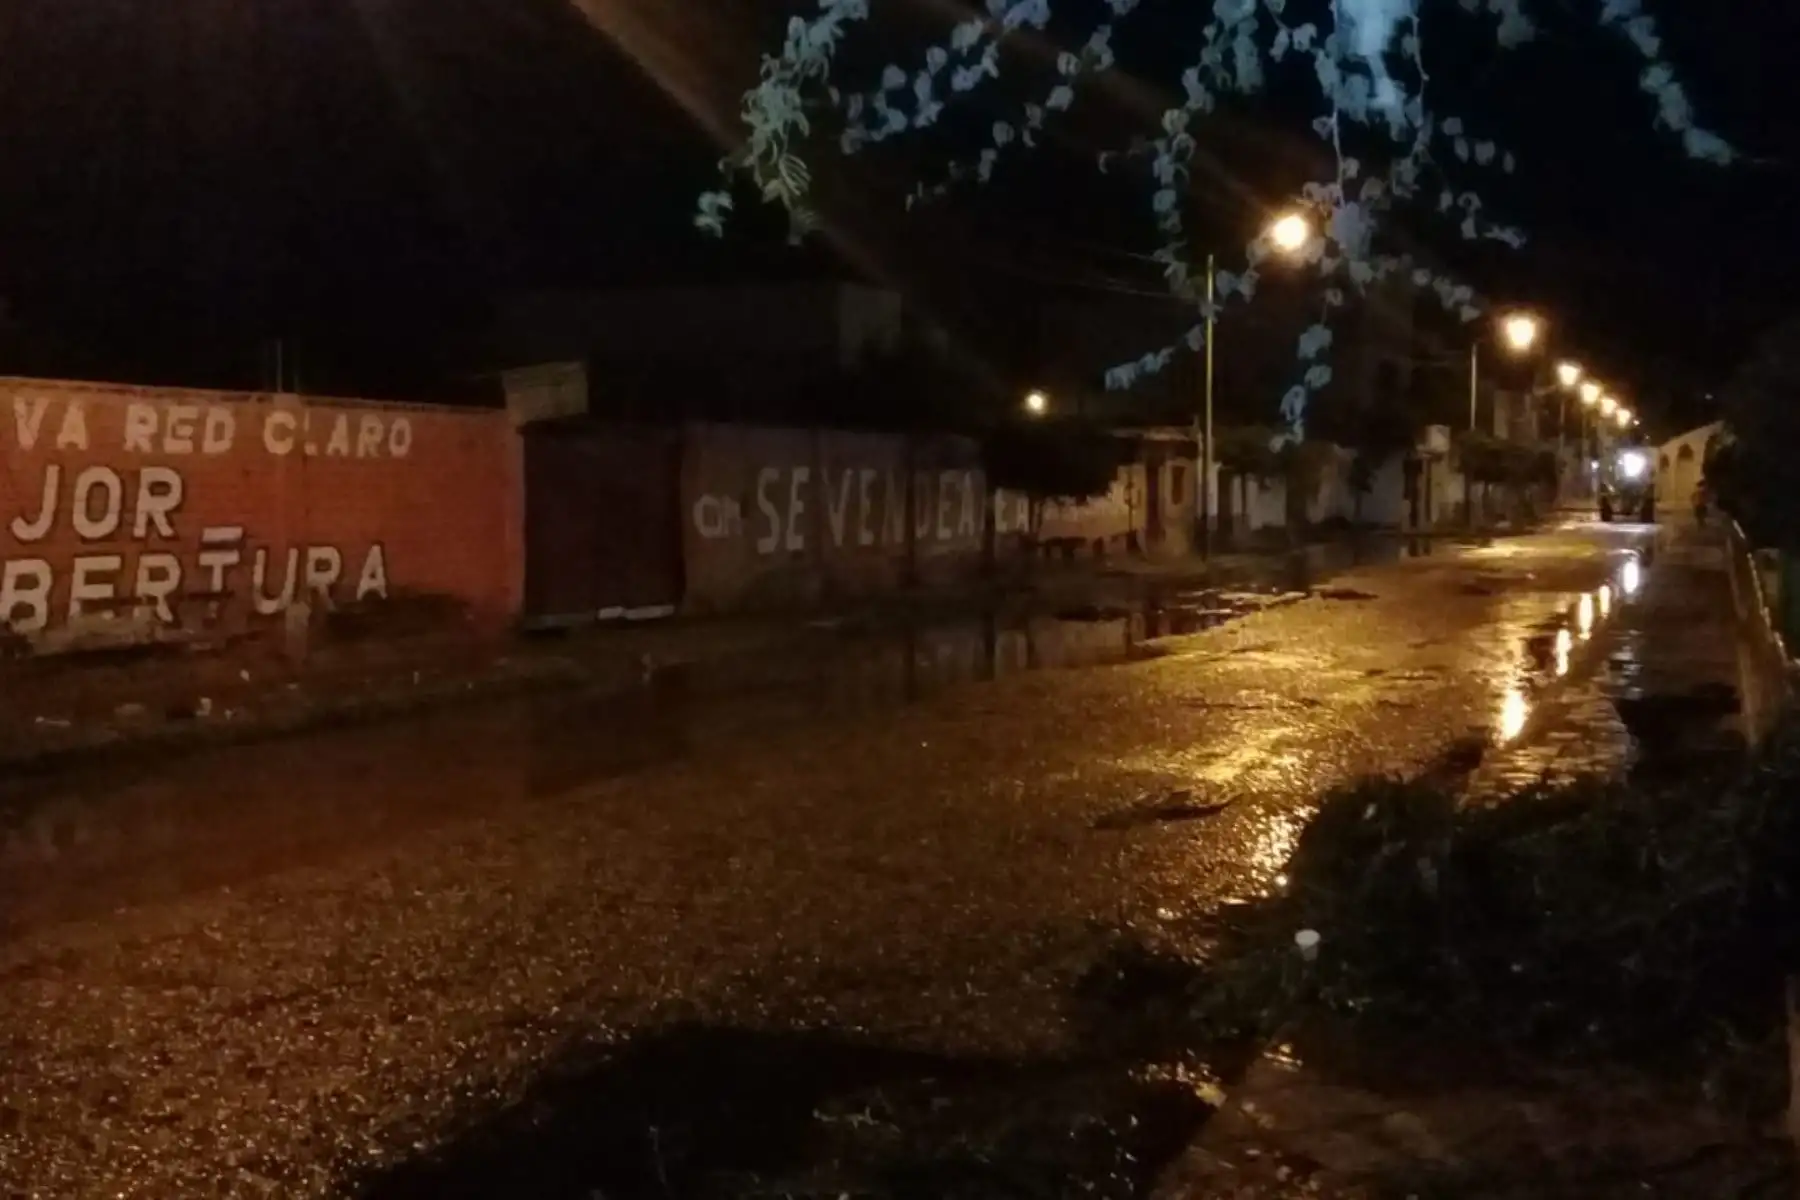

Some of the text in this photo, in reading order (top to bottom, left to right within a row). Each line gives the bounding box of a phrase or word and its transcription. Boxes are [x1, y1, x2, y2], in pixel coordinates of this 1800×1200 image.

[12, 397, 413, 458] VA RED CLARO
[10, 464, 185, 541] JOR
[757, 466, 810, 555] SE
[0, 525, 389, 633] BERTURA
